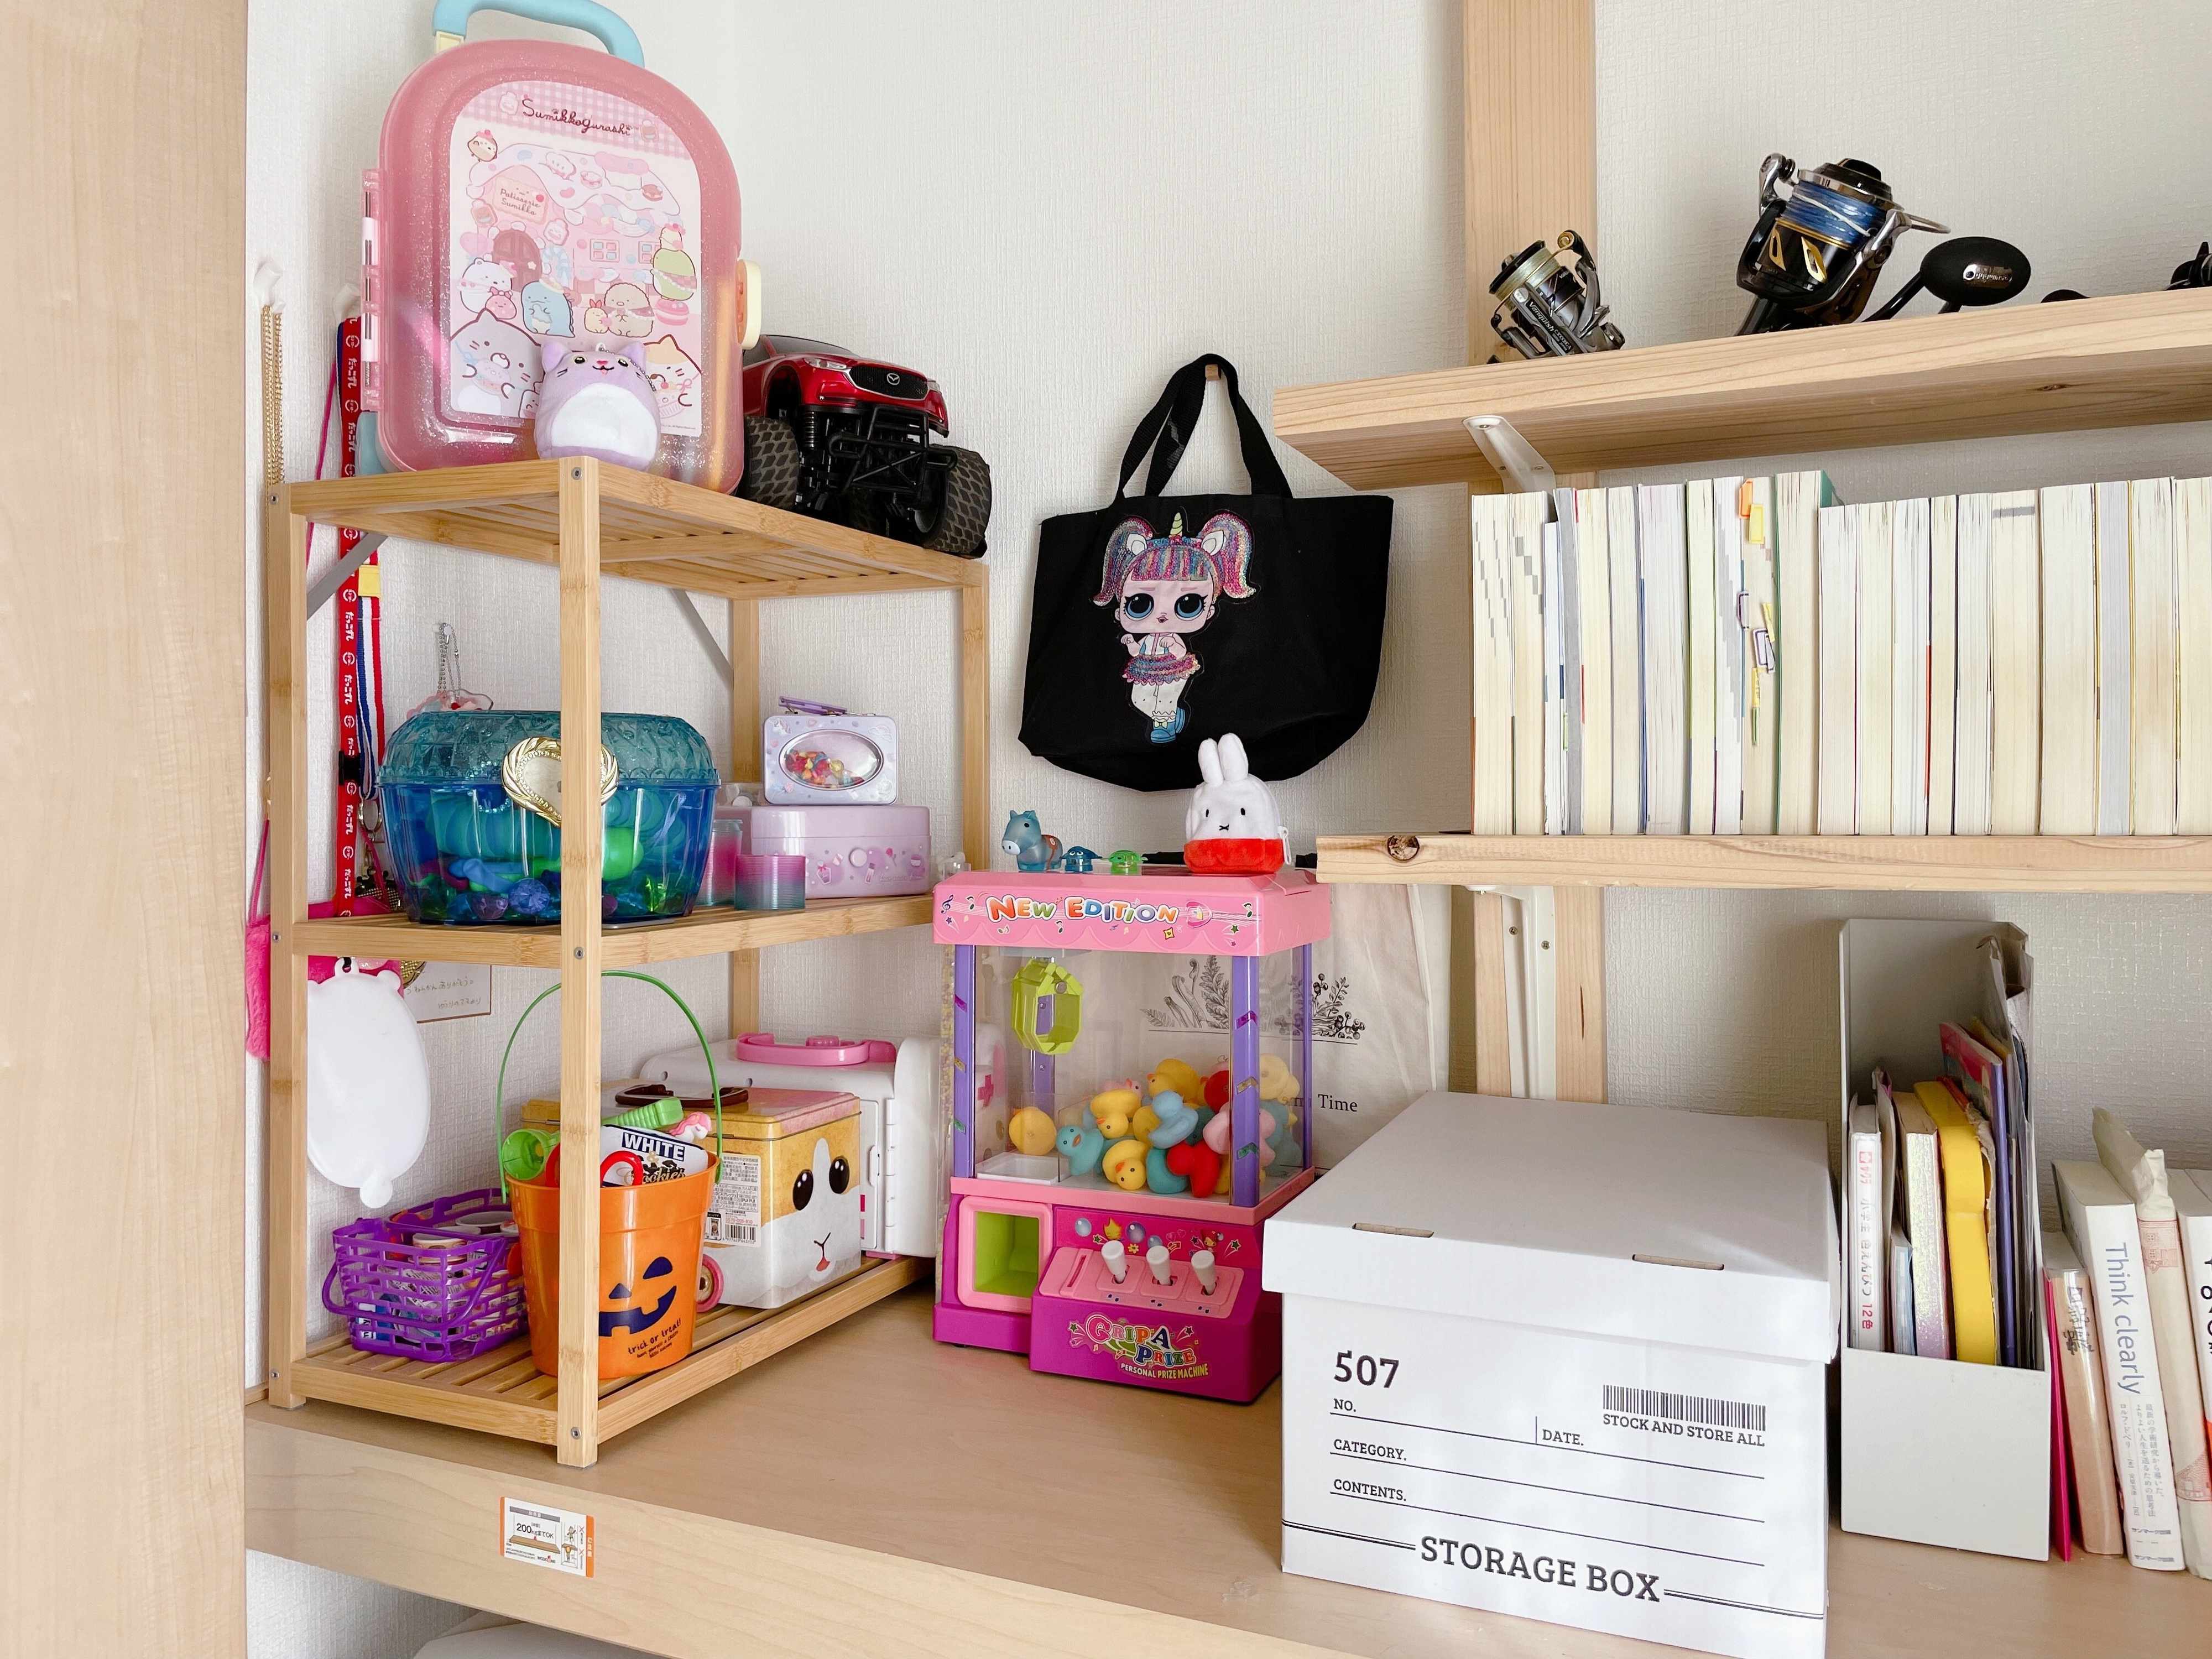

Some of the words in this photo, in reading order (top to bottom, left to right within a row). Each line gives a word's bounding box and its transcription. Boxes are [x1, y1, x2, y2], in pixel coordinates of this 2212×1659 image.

[521, 98, 630, 136] Sumikkogurashi
[500, 188, 541, 207] Patisserie
[1529, 301, 1554, 332] Vanquish
[345, 611, 354, 641] だっこずし
[344, 674, 353, 705] だっこずし
[344, 868, 352, 899] だっこずし
[1318, 1094, 1358, 1112] Time
[624, 1133, 685, 1161] WHITE
[2105, 1242, 2134, 1307] Think
[1861, 1303, 1874, 1329] 12色
[628, 1340, 649, 1354] trick
[650, 1334, 659, 1344] or
[661, 1317, 682, 1337] treat!
[1134, 1344, 1196, 1368] PRIZE
[1333, 1350, 1400, 1389] 507
[2114, 1314, 2145, 1395] clearly
[1120, 1363, 1156, 1378] PERSONAL
[1157, 1369, 1177, 1379] PRIZE
[1177, 1363, 1209, 1379] MACHINE
[1333, 1398, 1357, 1412] NO.
[1542, 1428, 1584, 1447] DATE.
[1603, 1413, 1649, 1431] STOCK
[1651, 1420, 1683, 1436] AND
[1687, 1426, 1734, 1443] STORE
[1736, 1432, 1765, 1447] ALL
[1333, 1438, 1407, 1461] CATEGORY.
[1333, 1478, 1407, 1501] CONTENTS.
[1421, 1535, 1576, 1588] STORAGE
[1586, 1563, 1660, 1603] BOX
